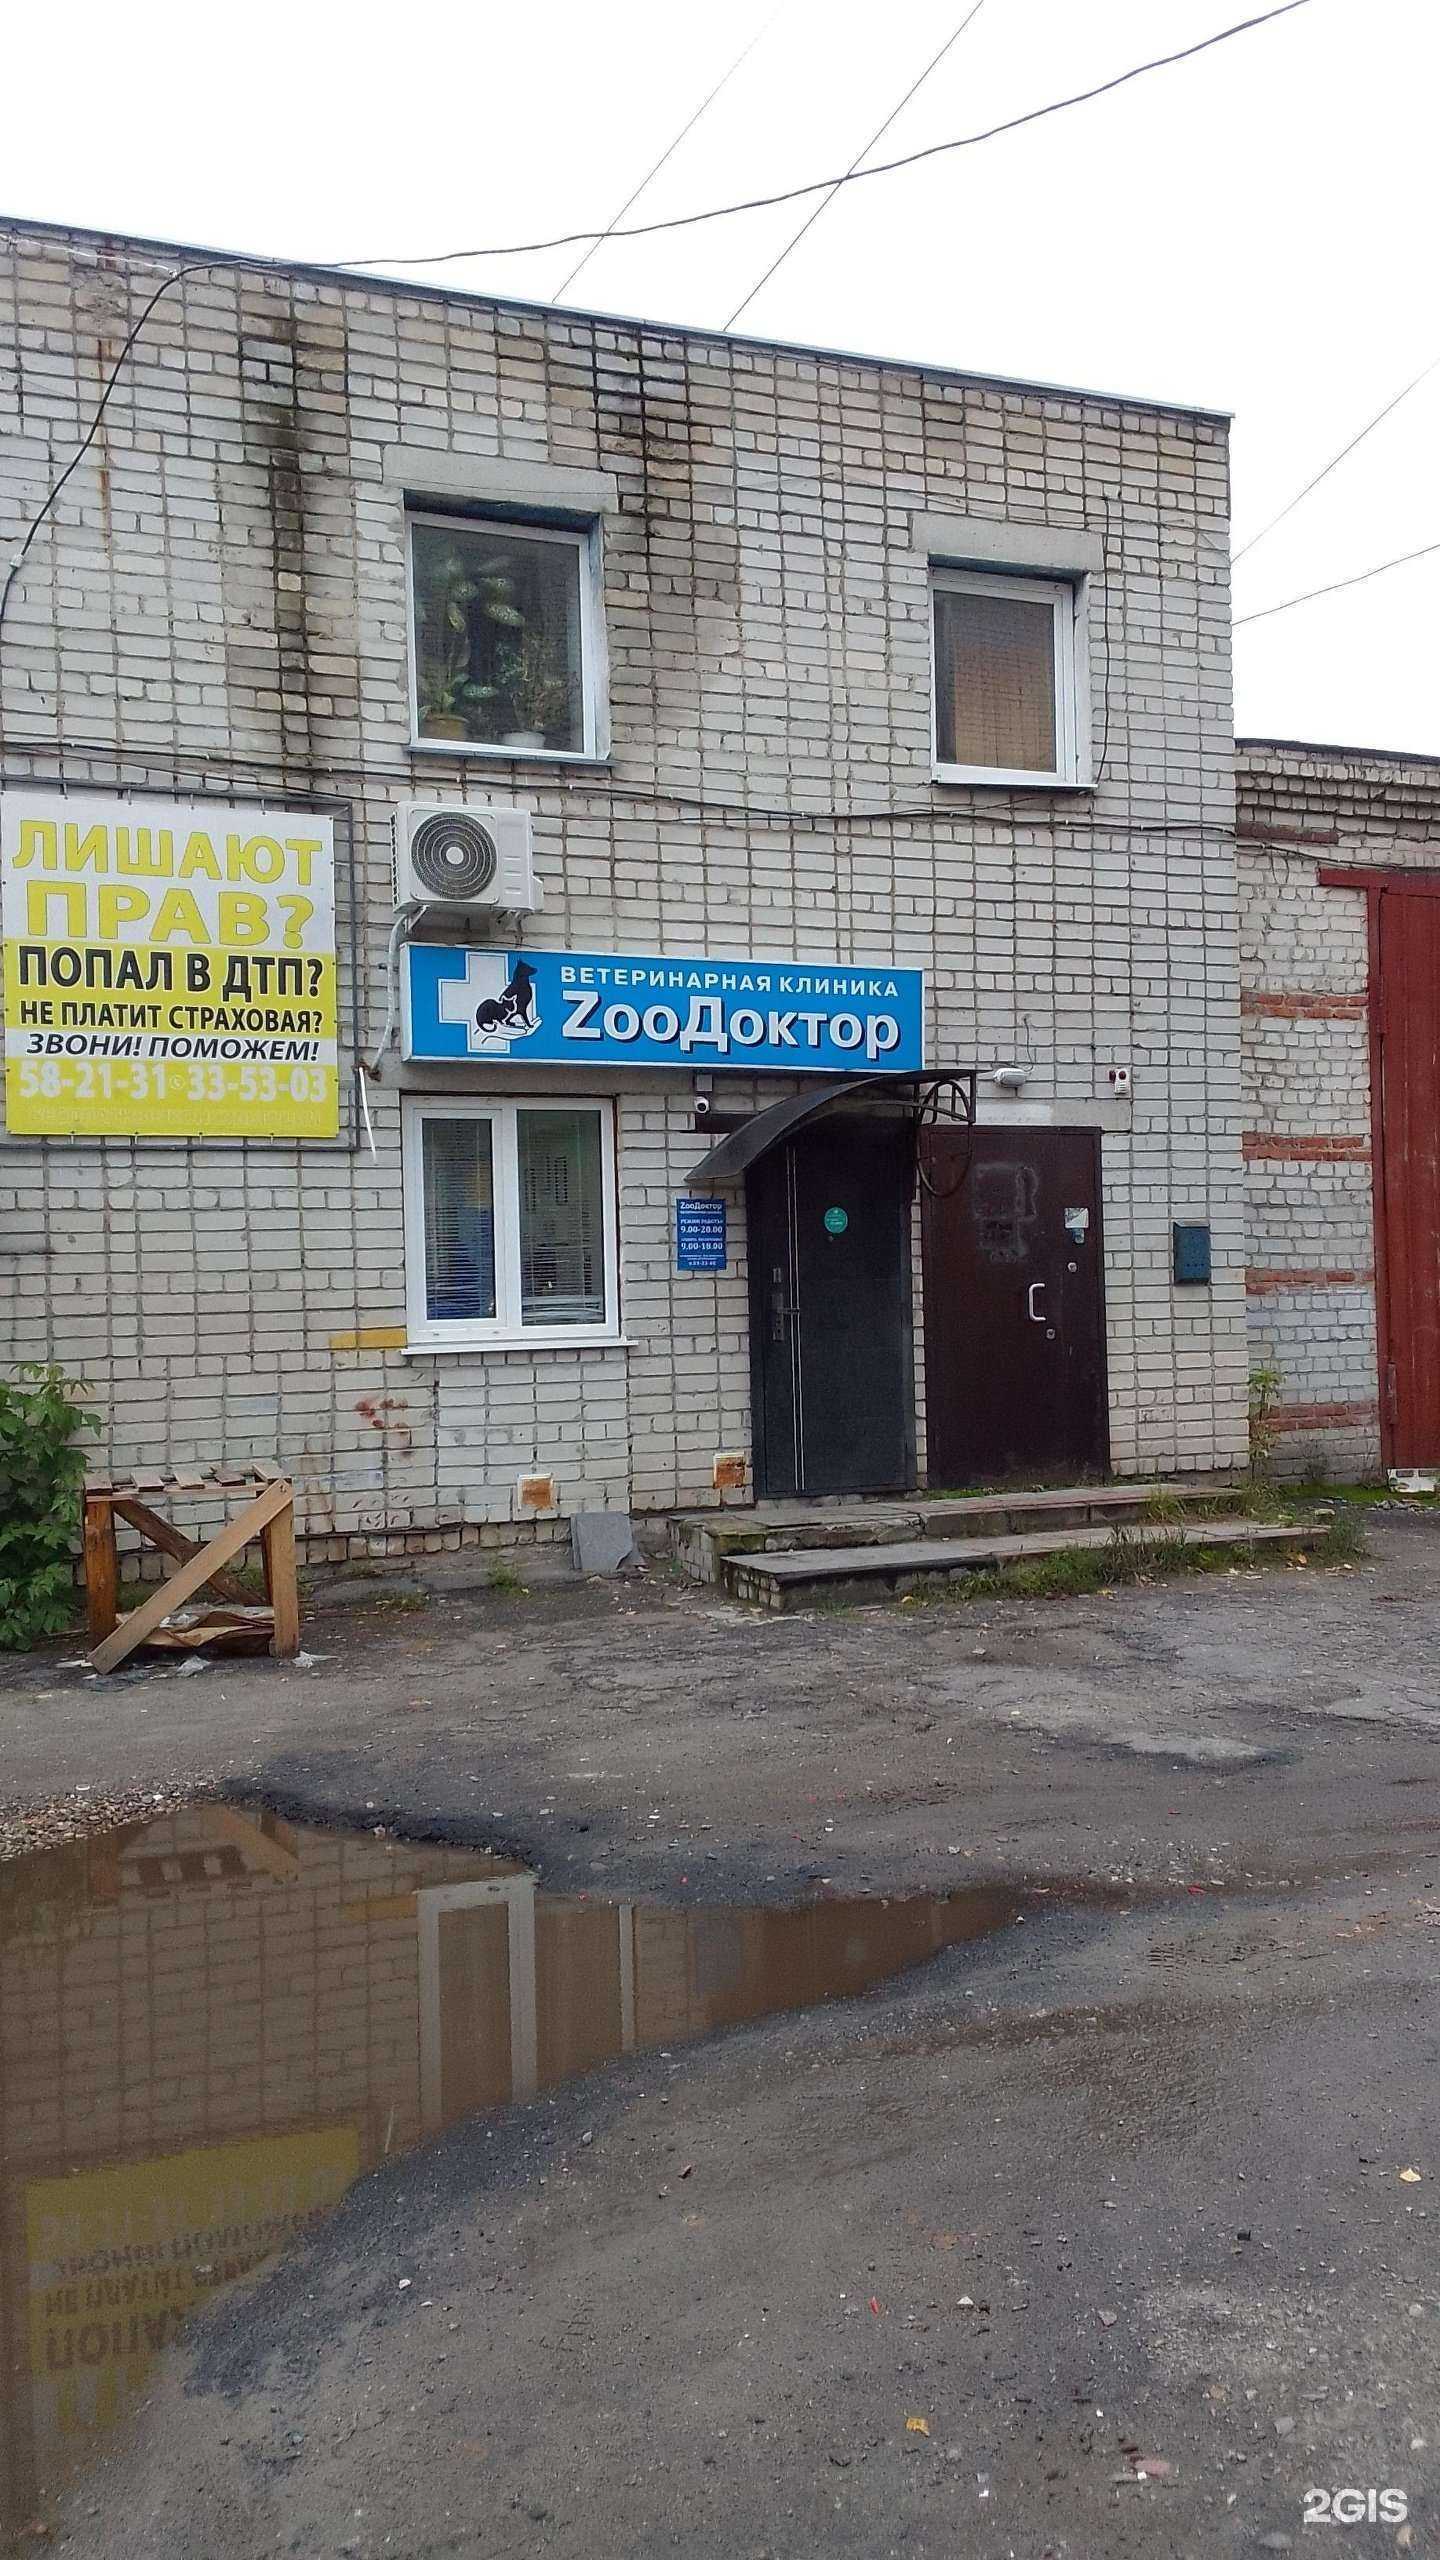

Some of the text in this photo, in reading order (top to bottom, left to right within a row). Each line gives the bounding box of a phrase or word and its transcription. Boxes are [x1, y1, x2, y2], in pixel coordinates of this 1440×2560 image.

[12, 819, 323, 886] ЛИШАЮТ
[26, 879, 315, 949] ПРАВ?
[18, 945, 324, 1003] ПОПАЛ В ДТП?
[560, 965, 899, 998] ВЕТЕРИНАРНАЯ КЛИНИКА
[20, 1000, 323, 1034] НЕ ПЛАТИТ СТРАХОВАЯ?
[561, 990, 901, 1061] ZooДоктор
[26, 1033, 320, 1062] ЗВОНИ! ПОМОЖЕМ!
[19, 1060, 328, 1102] 58-21-31 33-53-03
